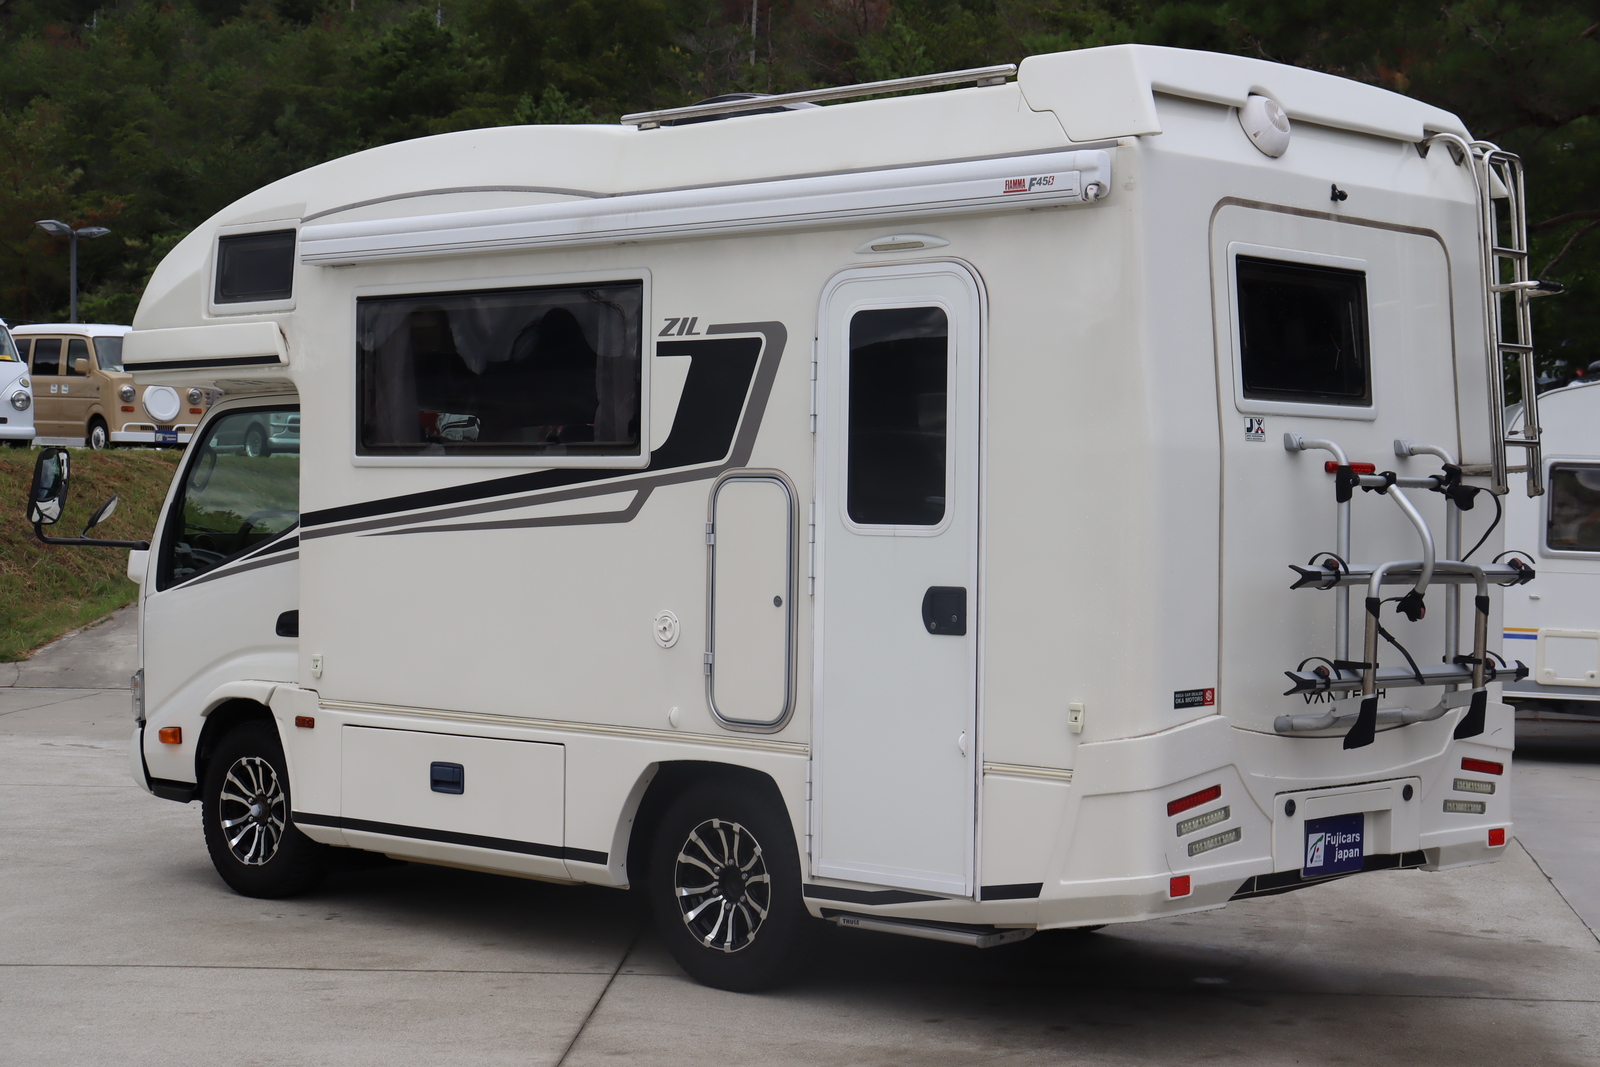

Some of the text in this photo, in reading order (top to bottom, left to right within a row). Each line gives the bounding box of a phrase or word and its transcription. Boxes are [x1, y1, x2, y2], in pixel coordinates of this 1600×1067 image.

[1005, 178, 1026, 190] FIAMMA
[658, 317, 701, 337] ZIL
[1303, 688, 1386, 704] VANEH
[1325, 832, 1360, 847] Fujicars
[1334, 847, 1360, 862] japan
